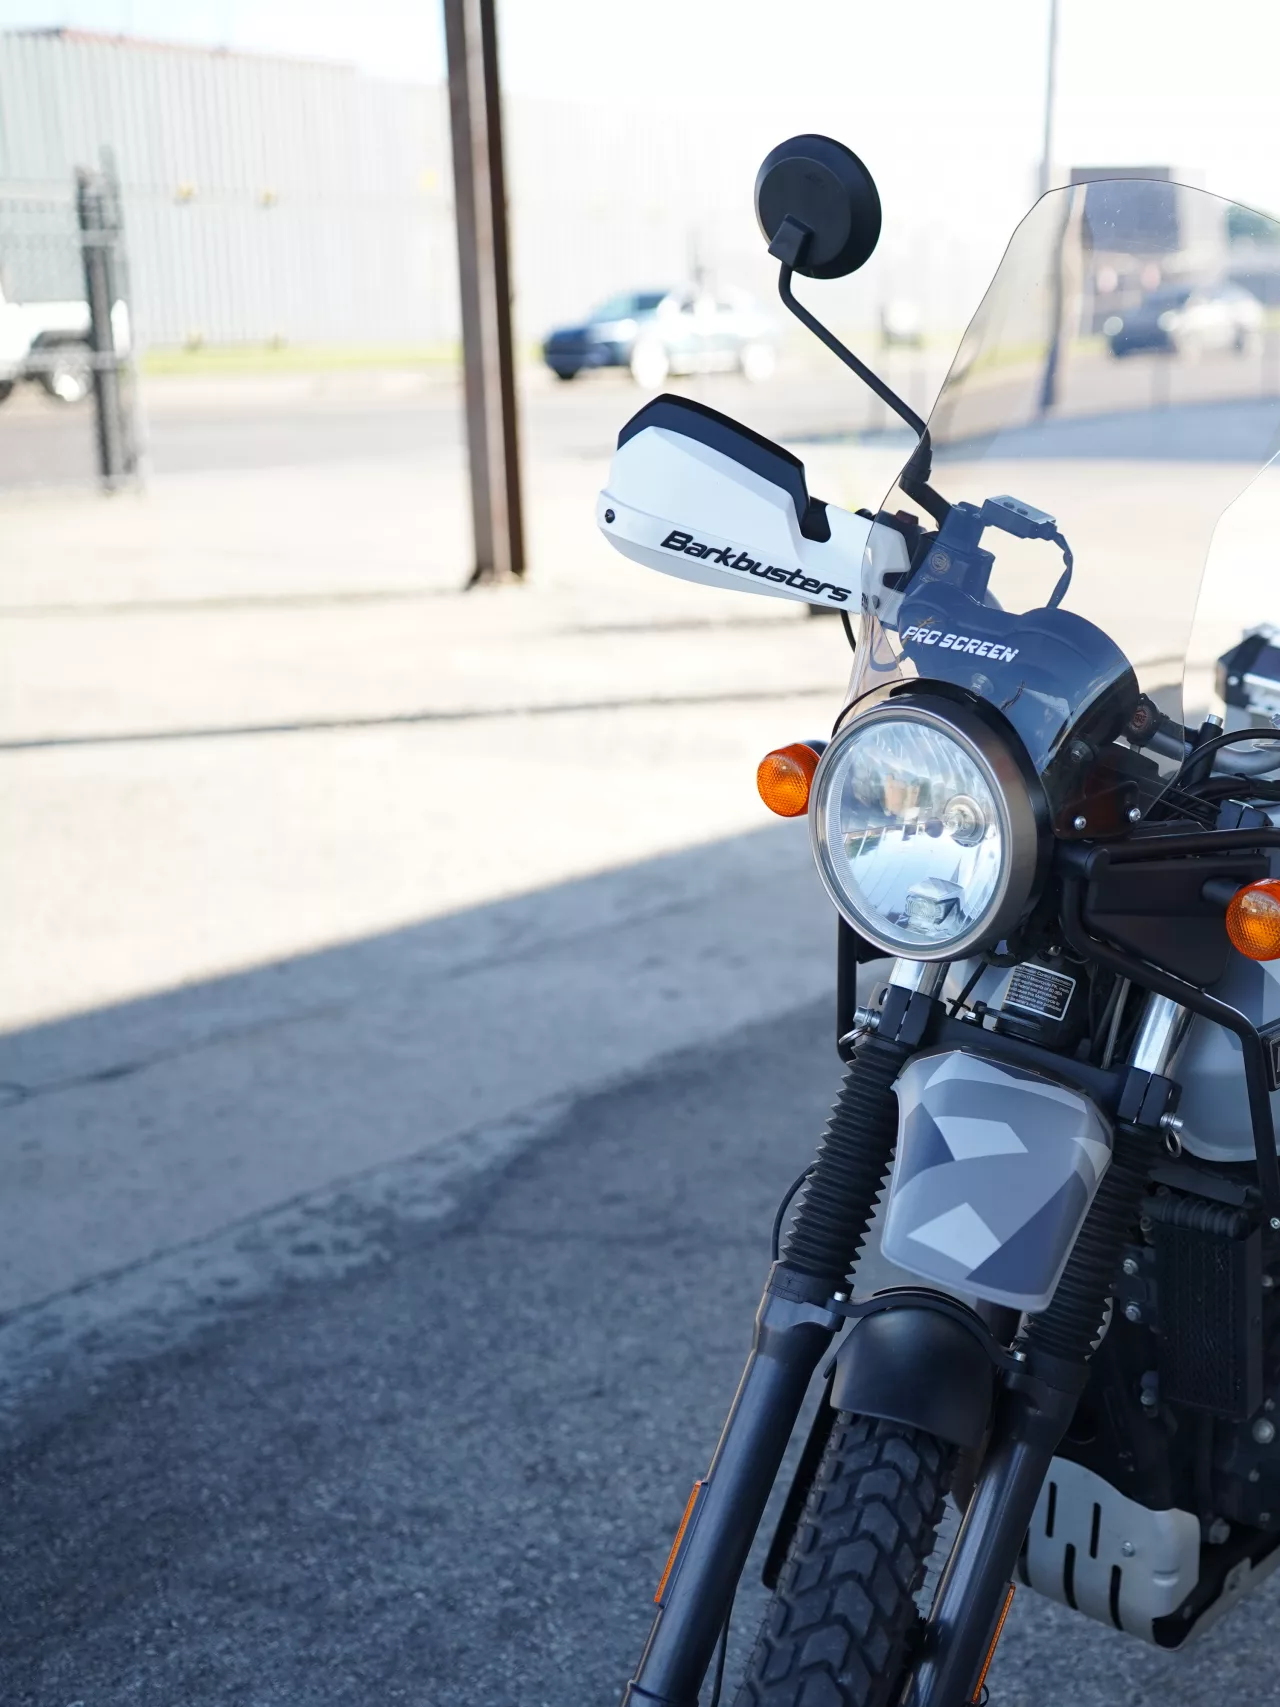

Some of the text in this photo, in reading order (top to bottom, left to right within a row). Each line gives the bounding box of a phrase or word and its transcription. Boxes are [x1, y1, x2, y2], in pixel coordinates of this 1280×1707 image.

[660, 530, 852, 602] Barkbusters
[901, 626, 1020, 662] PRO SCREEN
